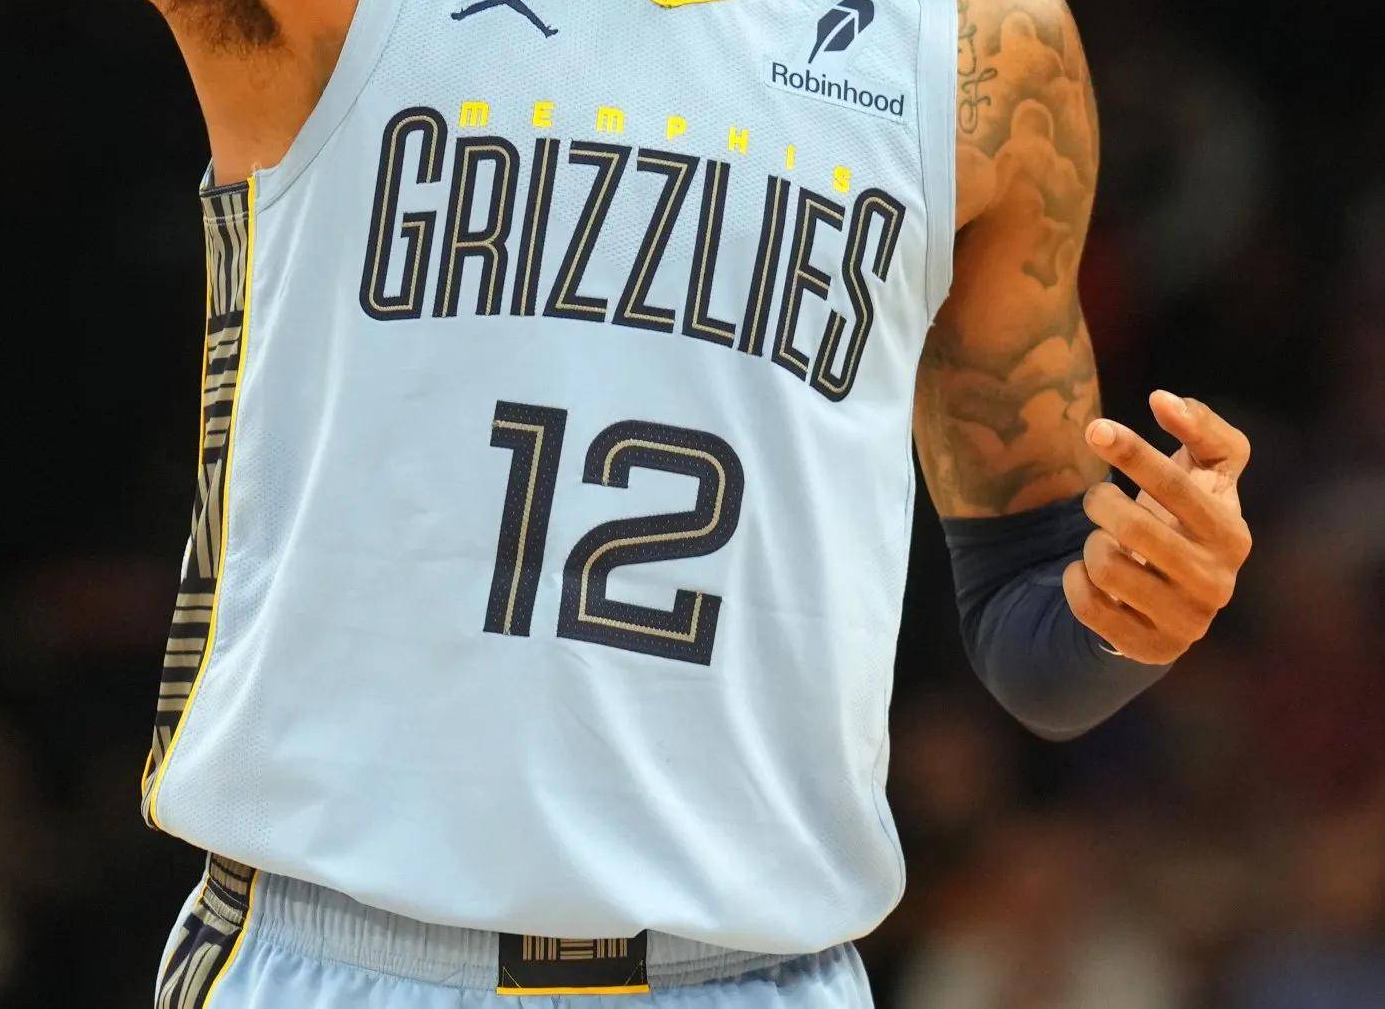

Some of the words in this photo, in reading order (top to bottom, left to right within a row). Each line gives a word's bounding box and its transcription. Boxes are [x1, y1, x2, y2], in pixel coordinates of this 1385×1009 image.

[458, 98, 853, 194] MEMPHIS
[771, 61, 905, 117] Robinhood
[359, 106, 907, 403] GRIZZLIES
[482, 399, 746, 667] 12
